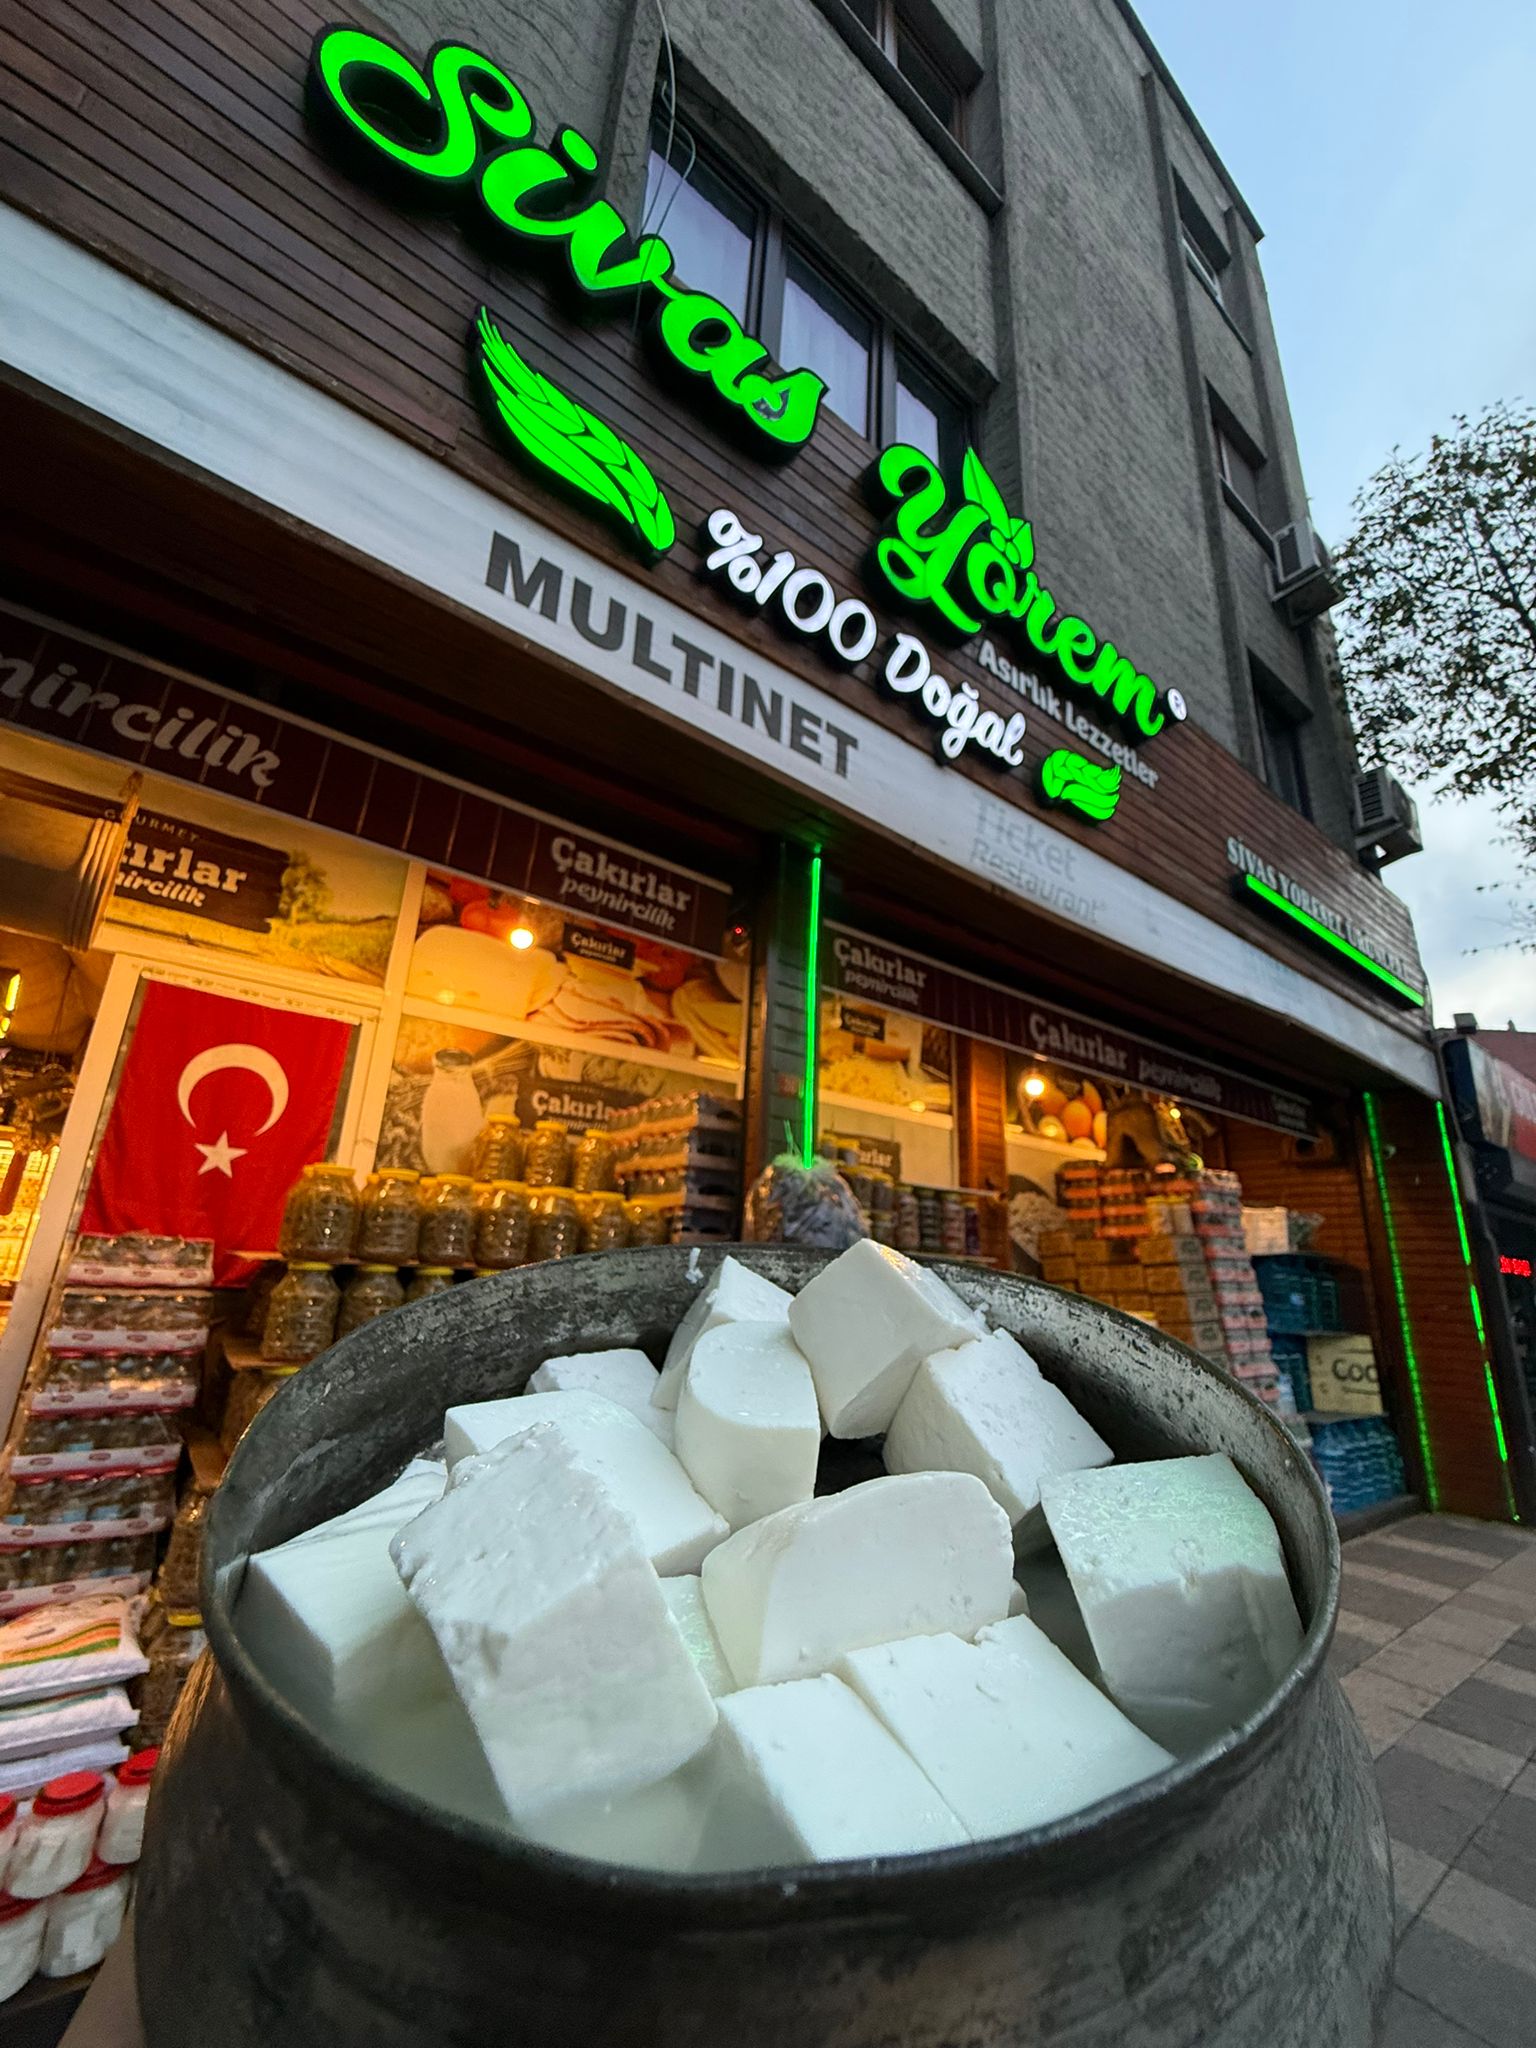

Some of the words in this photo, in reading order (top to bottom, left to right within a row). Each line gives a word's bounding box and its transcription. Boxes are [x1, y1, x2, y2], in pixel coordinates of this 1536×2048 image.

[320, 30, 826, 443] Sivas
[485, 530, 859, 778] MULTINET
[706, 508, 877, 661] %100
[885, 632, 1026, 766] Doğal
[979, 640, 1062, 720] Asırlık
[1065, 701, 1158, 789] Lezzetler
[104, 809, 199, 842] GURMET
[552, 836, 691, 912] Çakırlar
[560, 876, 676, 931] peynircilik
[833, 938, 927, 988] Çakırlar
[1029, 1013, 1128, 1070] Çakırlar
